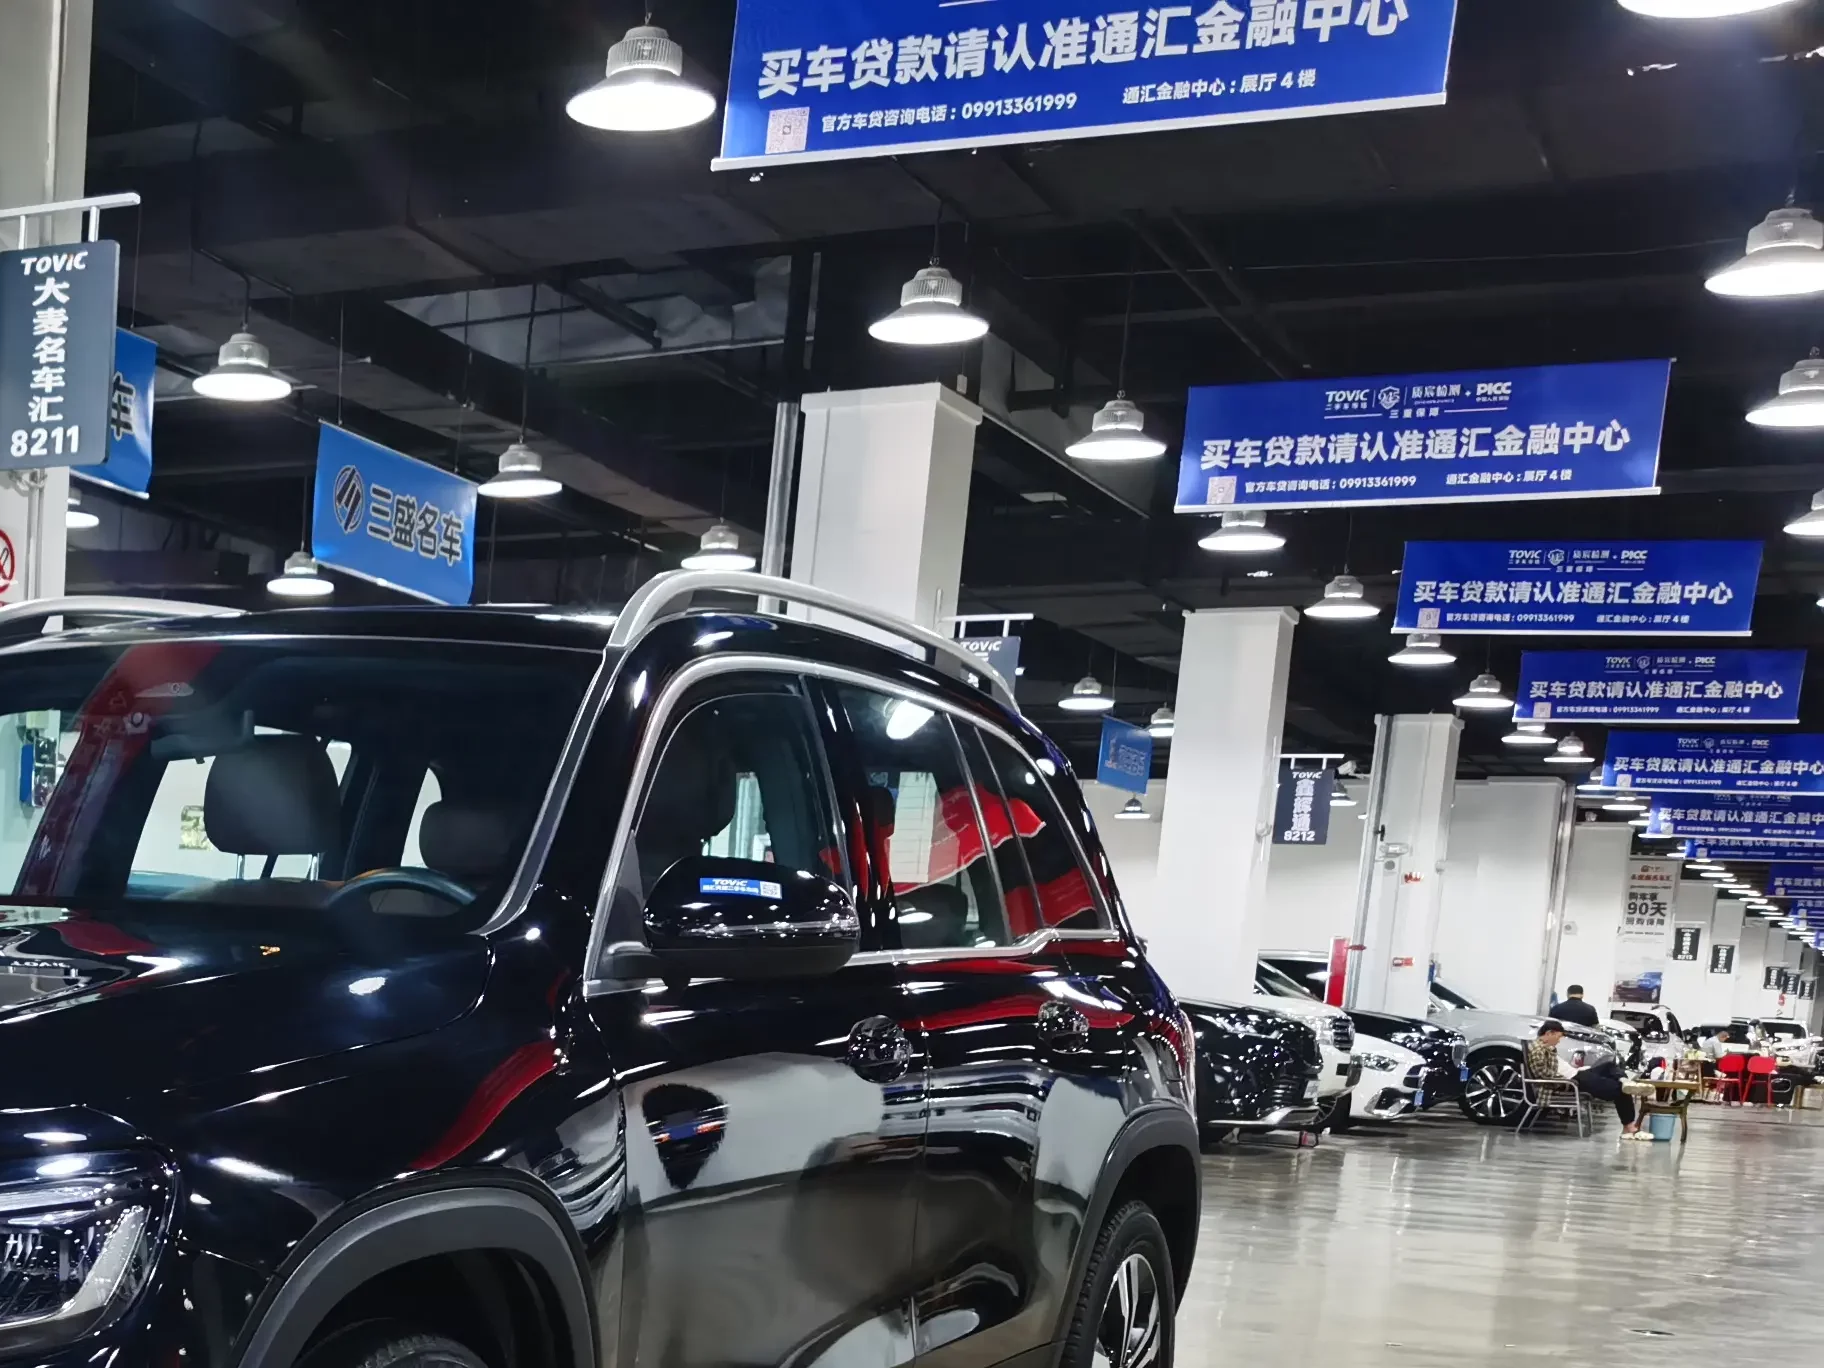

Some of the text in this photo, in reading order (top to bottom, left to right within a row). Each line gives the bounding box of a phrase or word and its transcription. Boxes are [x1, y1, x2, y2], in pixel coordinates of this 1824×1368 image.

[758, 0, 1409, 99] 买车贷款请认准通汇金融中心
[21, 251, 88, 276] TOVIC
[28, 276, 70, 423] 大麦名车汇
[1325, 388, 1370, 402] TOVIC
[1475, 381, 1512, 395] PICC
[10, 424, 80, 457] 8211
[1200, 418, 1631, 471] 买车贷款请认准通汇金融中心
[366, 482, 465, 567] 三盛名车
[1509, 549, 1542, 559] TOVIC
[1413, 580, 1734, 605] 买车贷款请认准通汇金融中心
[1529, 680, 1784, 699] 买车贷款请认准通汇金融中心
[1292, 771, 1323, 779] TOVIC
[1283, 830, 1316, 842] 8212
[1627, 901, 1668, 917] 90天
